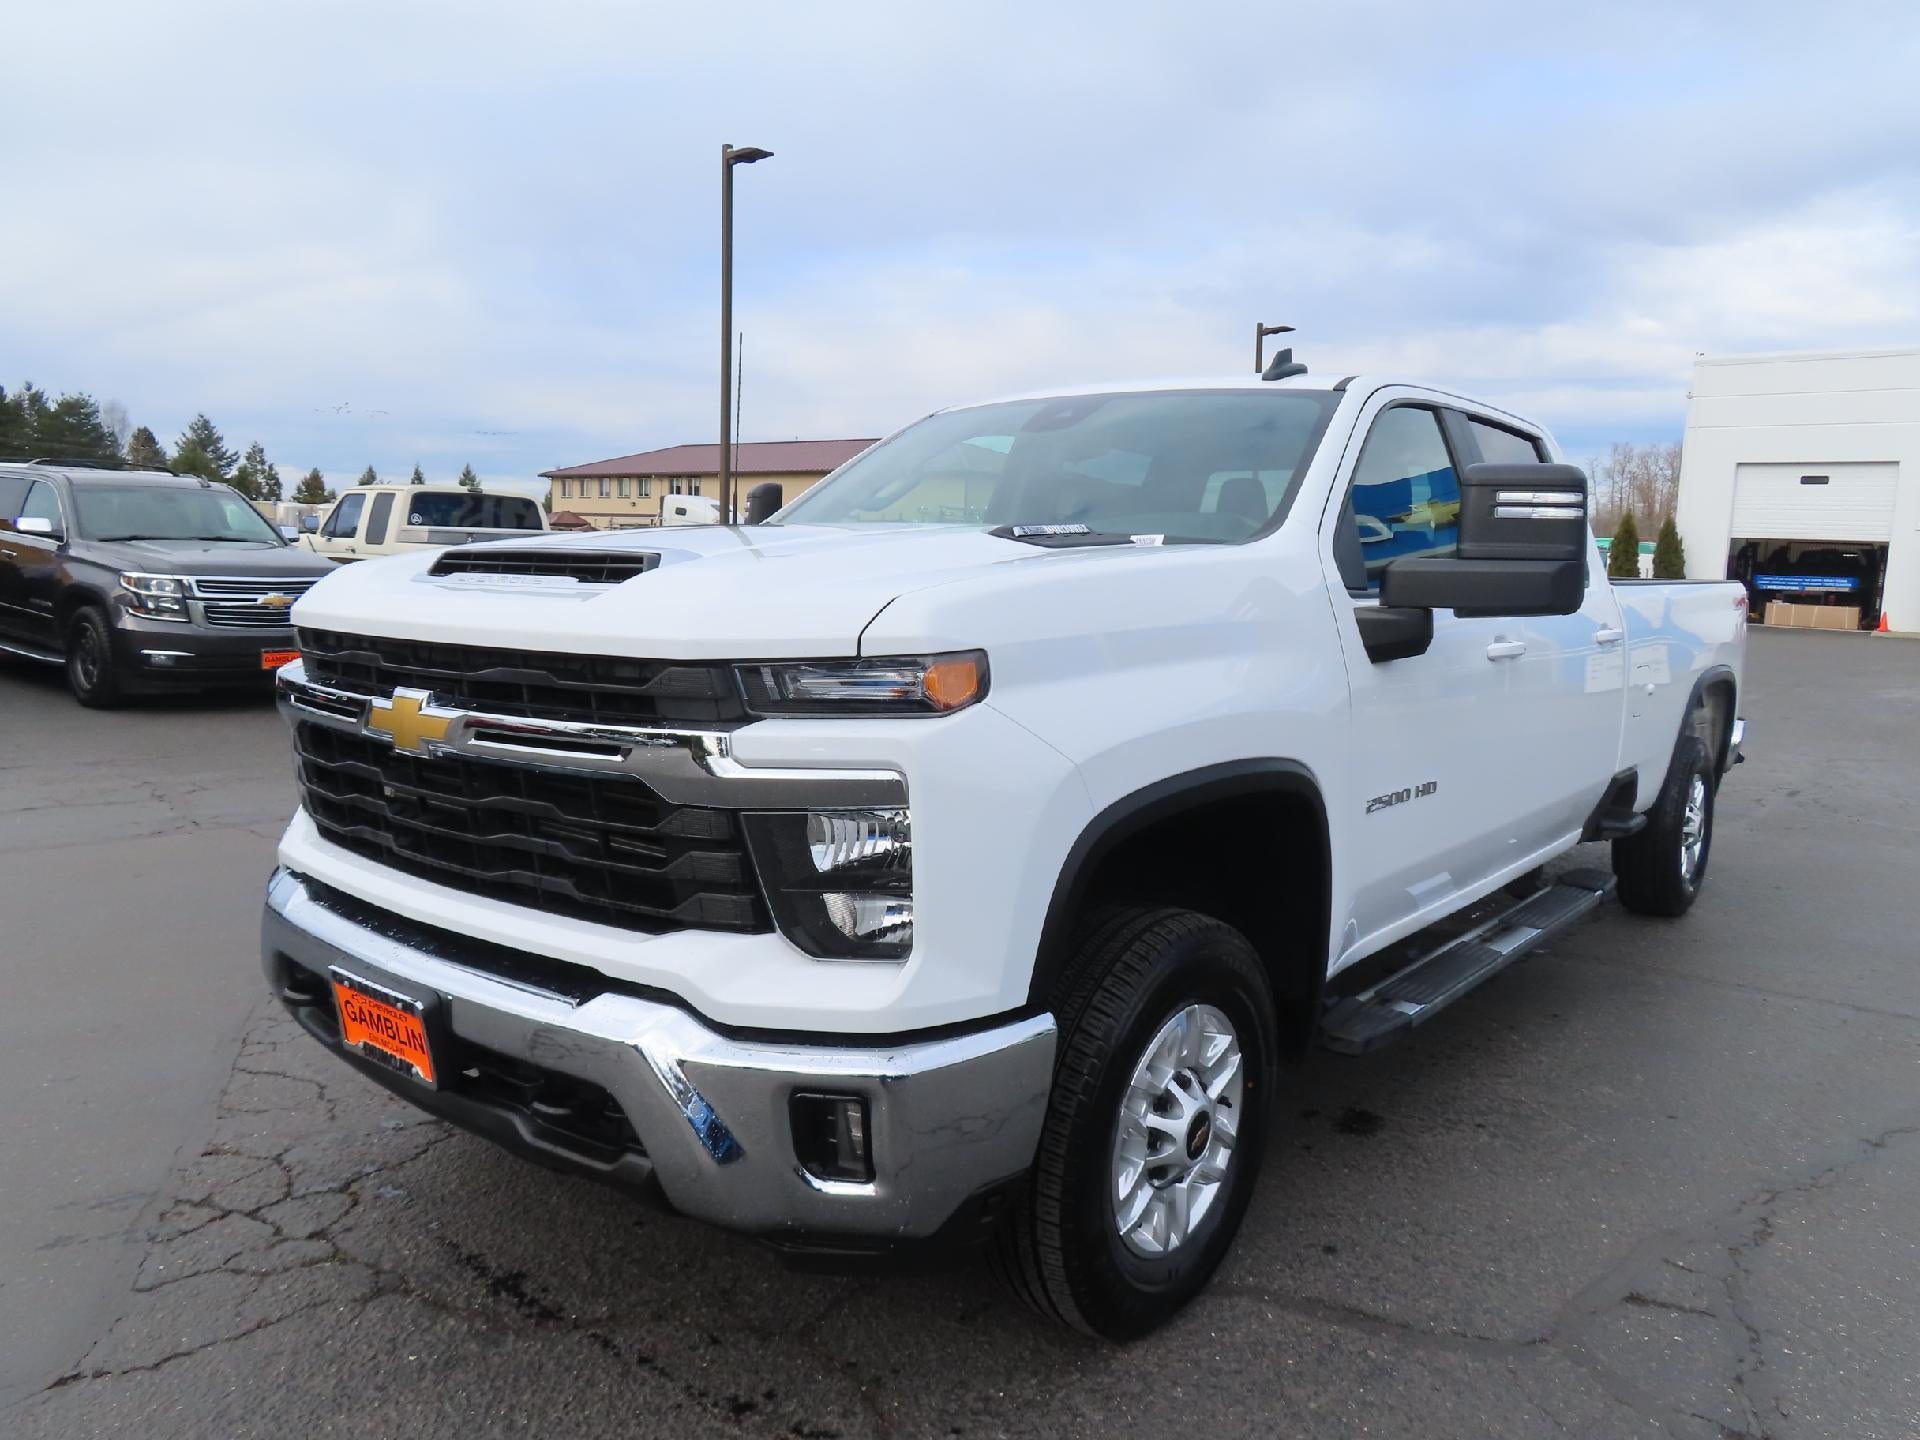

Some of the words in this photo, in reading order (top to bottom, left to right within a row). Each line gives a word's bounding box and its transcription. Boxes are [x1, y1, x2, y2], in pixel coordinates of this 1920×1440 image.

[1366, 788, 1411, 814] 2500
[1415, 781, 1437, 799] HD
[344, 999, 426, 1055] GAMBLIN
